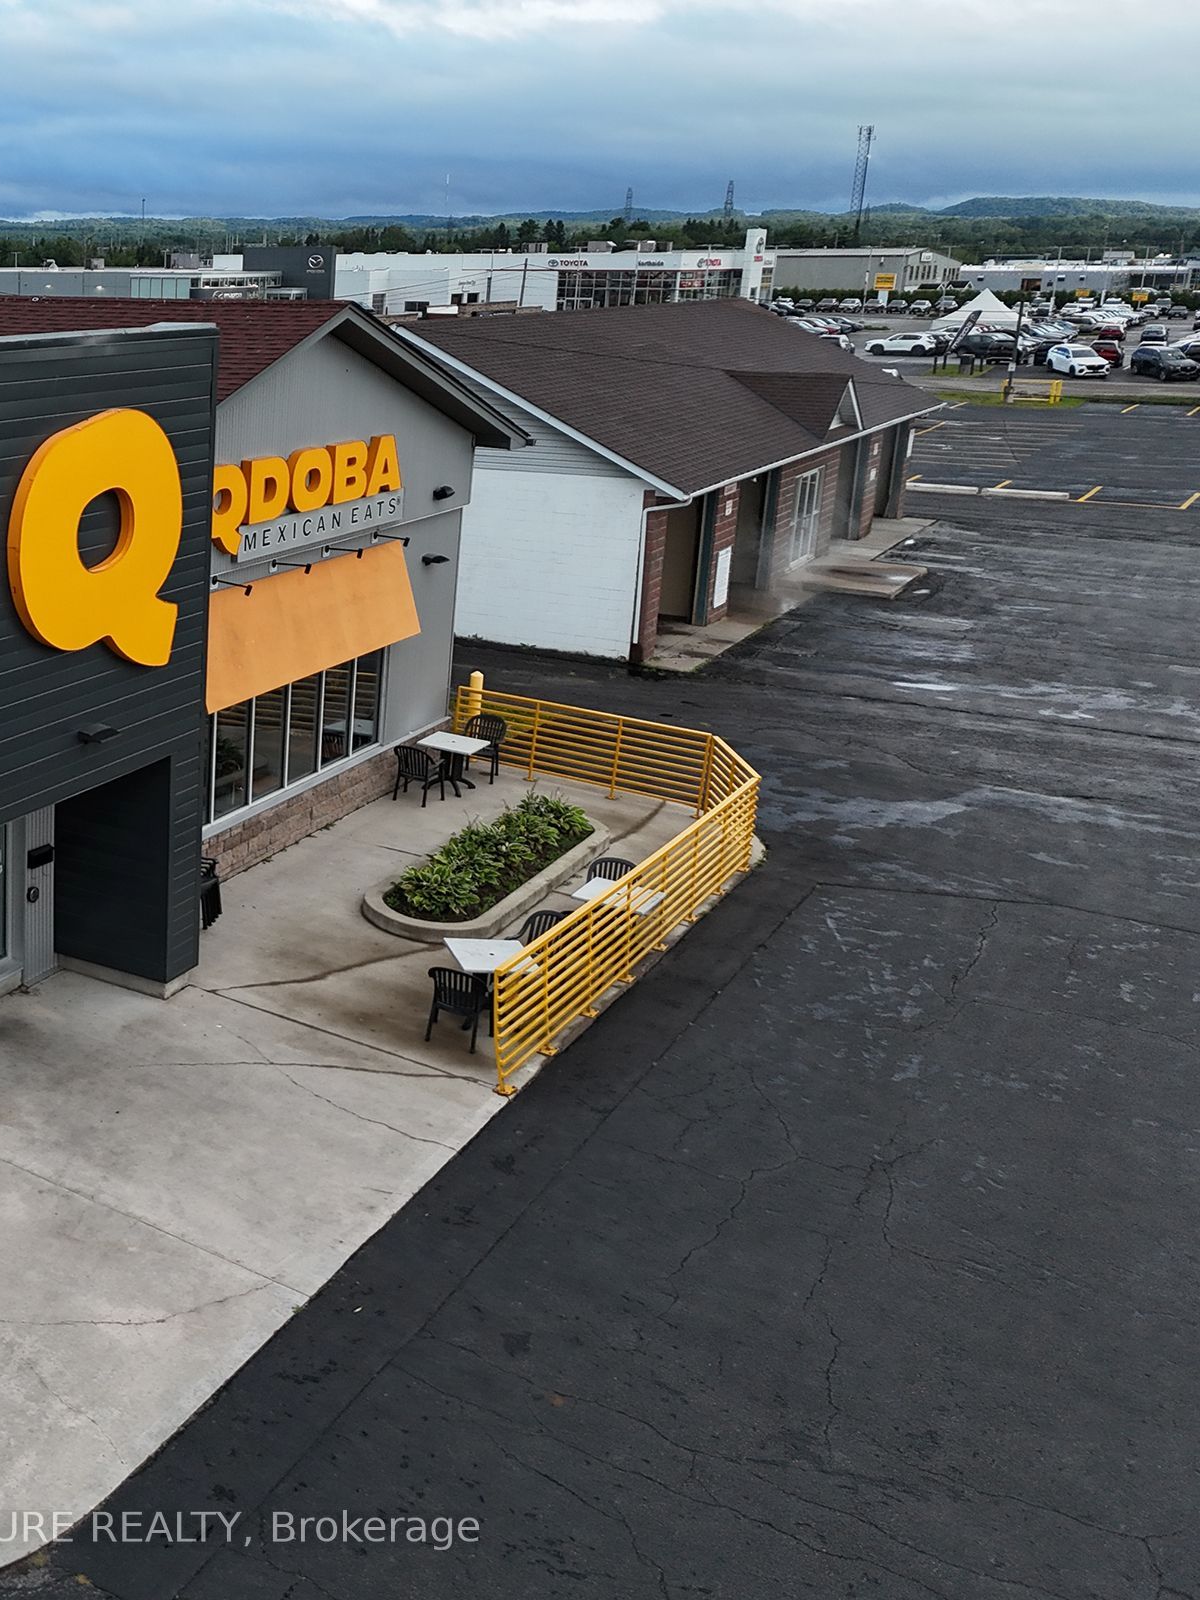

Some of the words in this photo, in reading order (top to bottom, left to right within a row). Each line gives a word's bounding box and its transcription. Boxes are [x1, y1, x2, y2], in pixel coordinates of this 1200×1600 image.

[560, 259, 588, 267] TOYOTA
[211, 434, 402, 556] QDOBA
[243, 511, 341, 552] MEXICAN
[7, 408, 182, 667] Q
